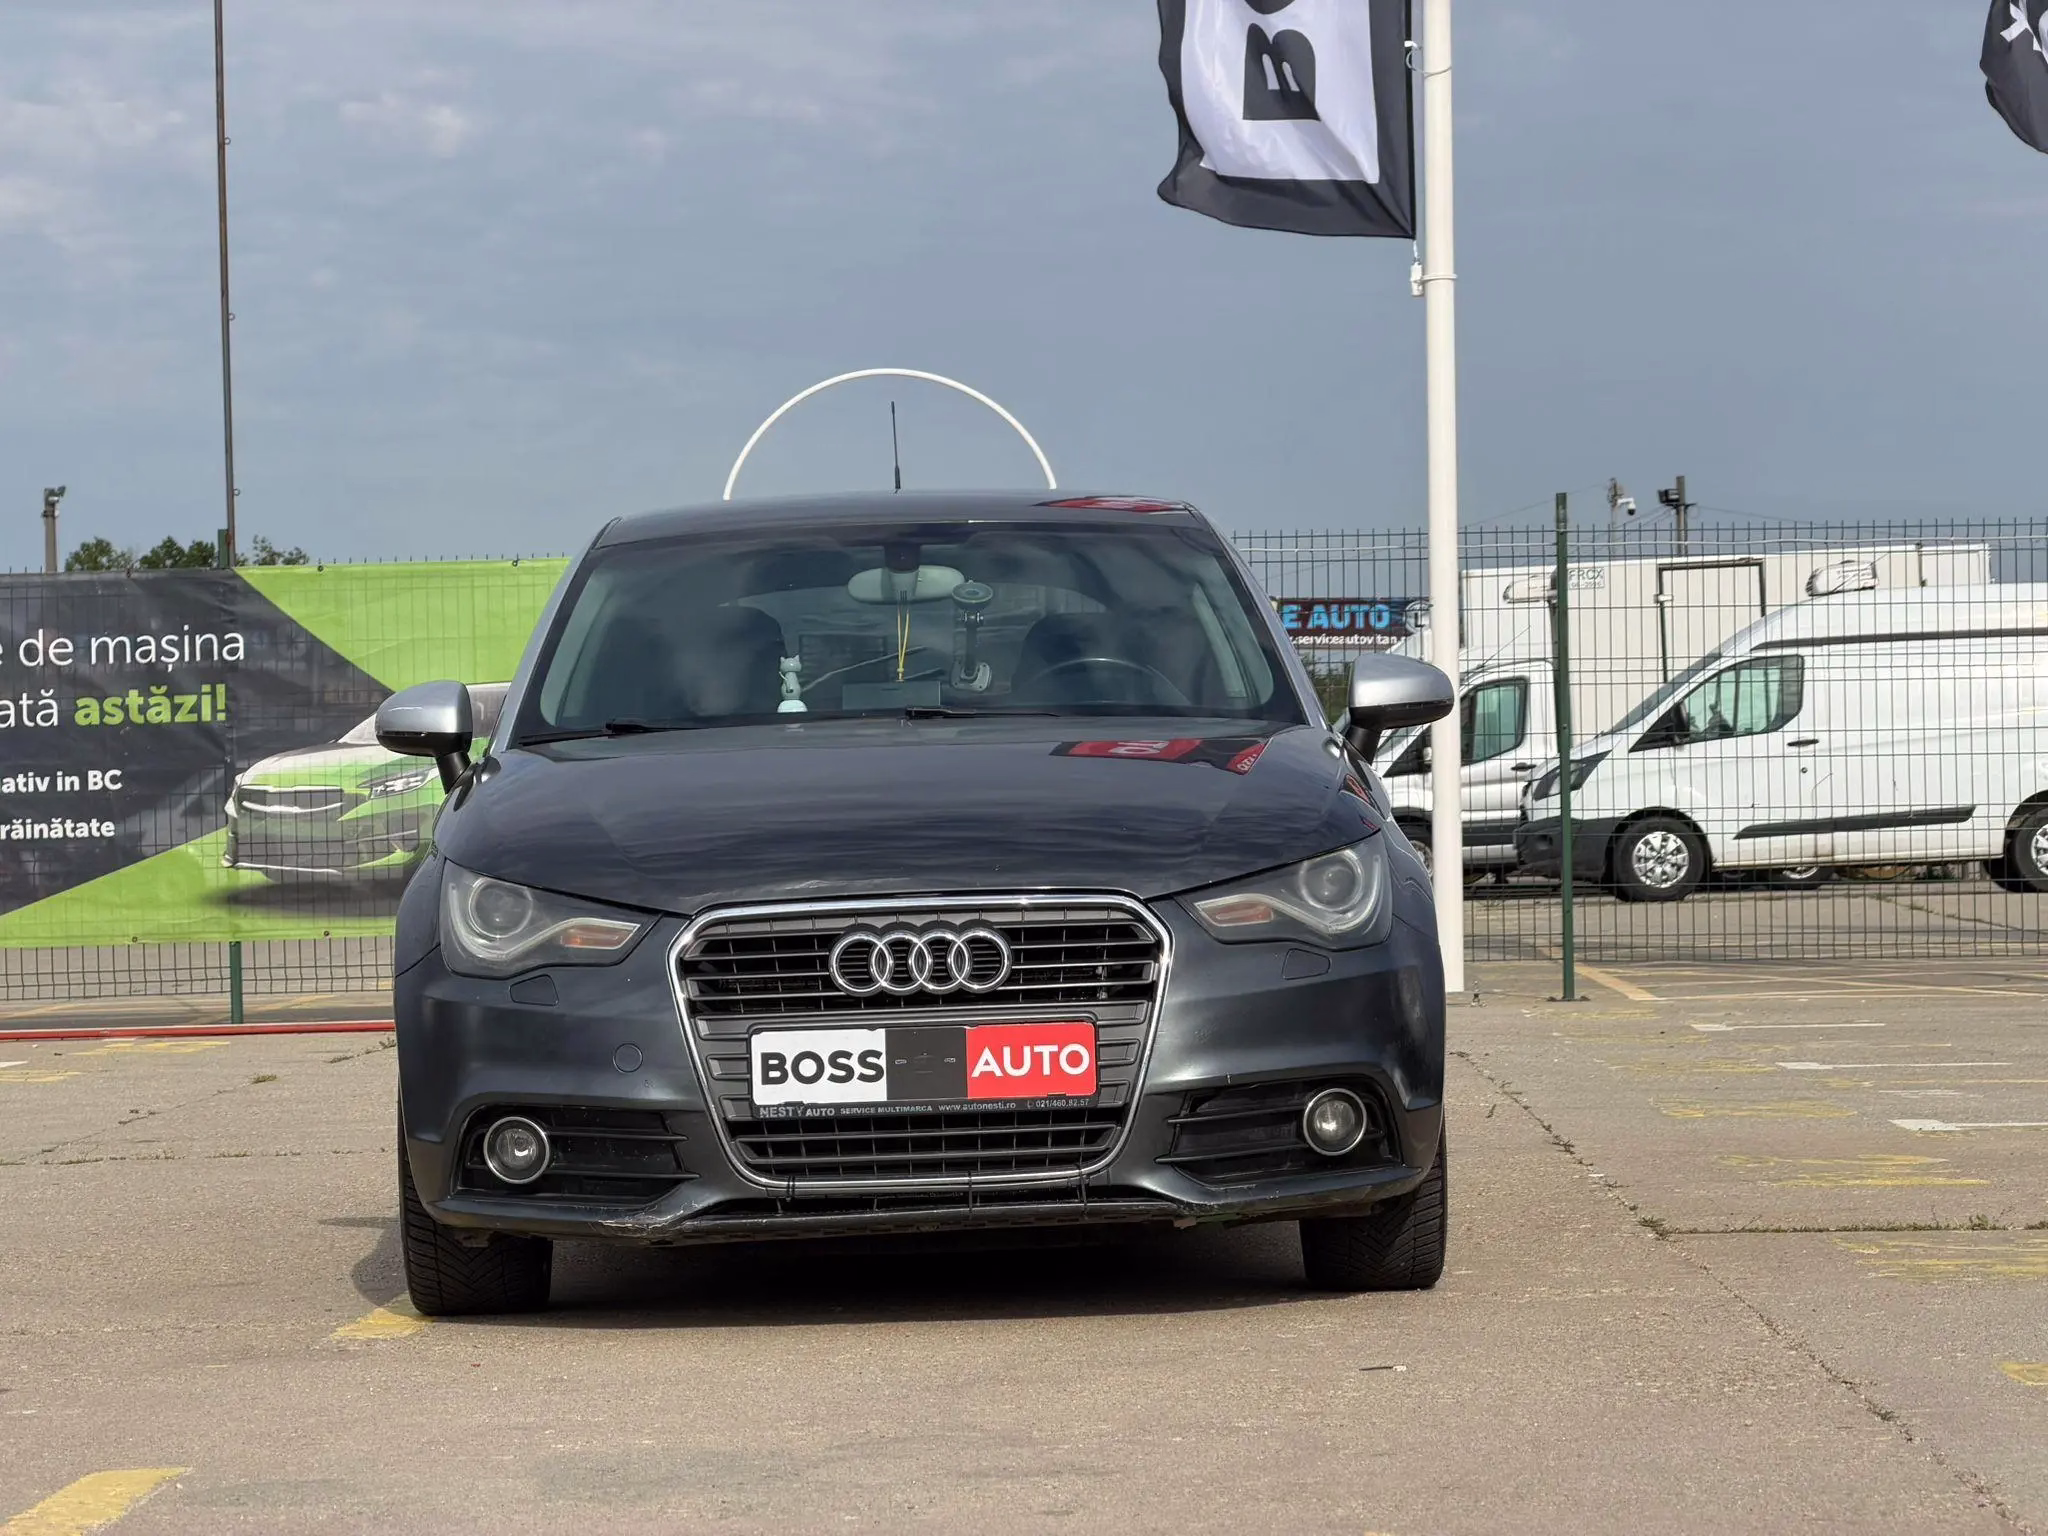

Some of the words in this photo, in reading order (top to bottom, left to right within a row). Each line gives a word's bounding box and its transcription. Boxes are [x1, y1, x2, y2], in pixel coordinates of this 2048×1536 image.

[1307, 603, 1391, 629] AUTO
[18, 628, 75, 667] de
[90, 624, 245, 672] mașina
[74, 683, 227, 726] astăzi!
[56, 770, 80, 792] in
[87, 769, 123, 791] BC
[760, 1049, 885, 1086] BOSS
[971, 1043, 1091, 1079] AUTO
[805, 1107, 836, 1117] AUTO
[840, 1106, 875, 1115] SERVICE
[877, 1104, 932, 1114] MULTIMARCA
[938, 1101, 1016, 1112] www.autonesti.ro
